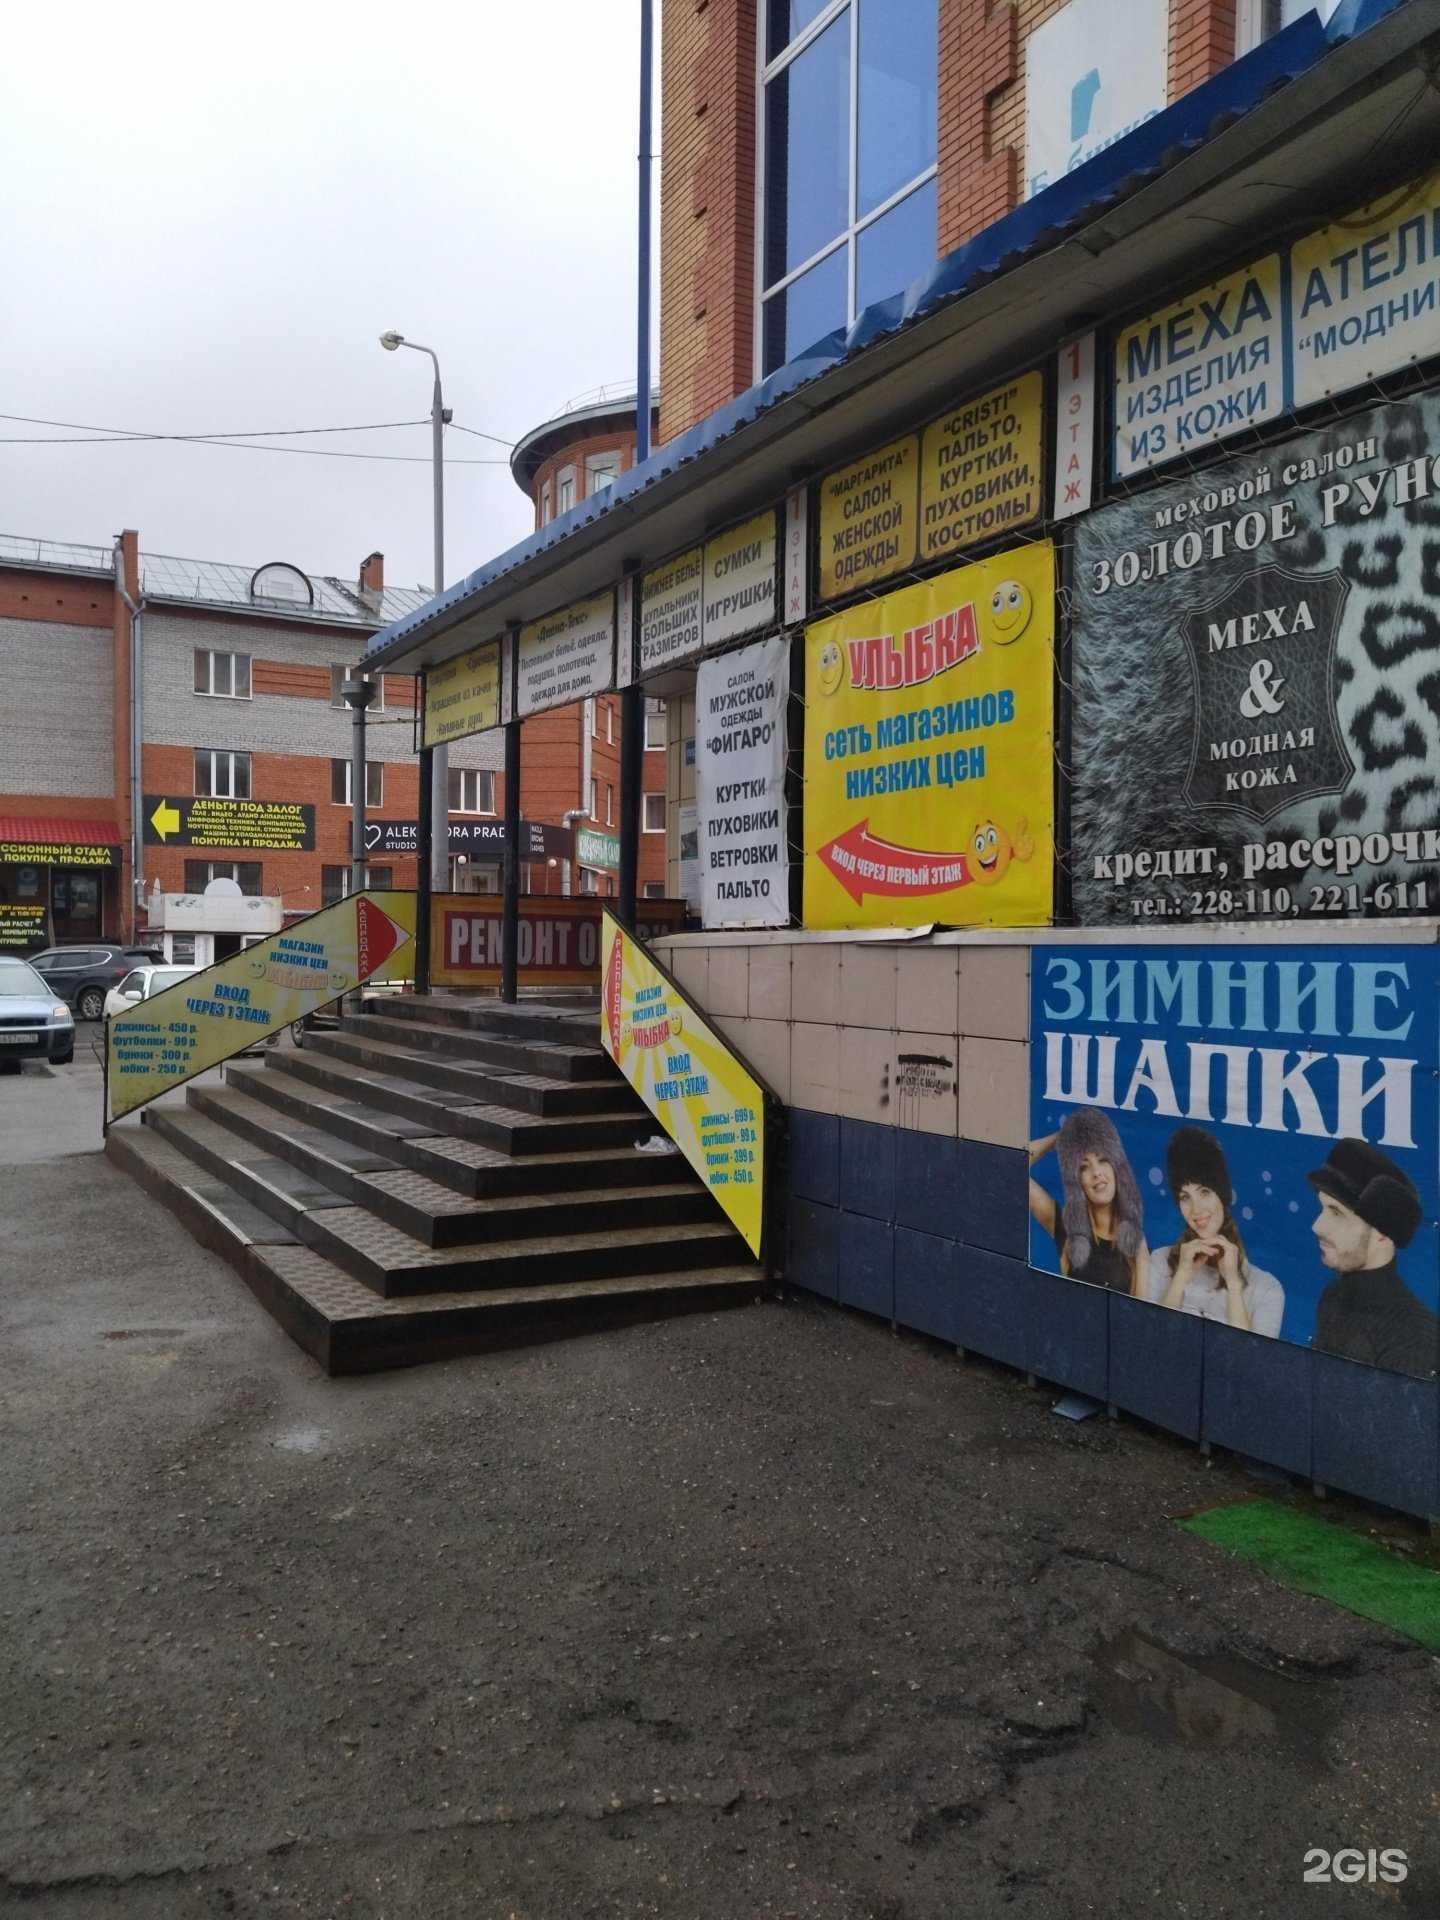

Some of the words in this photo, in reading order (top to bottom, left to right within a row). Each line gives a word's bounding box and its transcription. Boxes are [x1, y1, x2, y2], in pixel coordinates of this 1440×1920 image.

[1300, 206, 1440, 319] АТЕЛ
[1127, 277, 1272, 383] МЕХА
[1299, 280, 1440, 359] “МОДНИ
[1068, 342, 1080, 382] 1
[1127, 335, 1270, 424] ИЗДЕЛИЯ
[1130, 424, 1167, 462] ИЗ
[1177, 381, 1267, 445] КОЖИ
[938, 414, 1022, 467] ПАЛЬТО,
[1064, 394, 1082, 503] ЭТАЖ
[940, 442, 1019, 491] КУРТКИ,
[1154, 467, 1272, 530] меховой
[1282, 436, 1377, 488] салон
[844, 480, 892, 520] САЛОН
[925, 464, 1035, 525] ПУХОВИКИ,
[833, 503, 902, 554] ЖЕНСКОЙ
[928, 493, 1031, 550] КОСТЮМЫ
[1092, 499, 1297, 595] ЗОЛОТОЕ
[1322, 454, 1440, 528] РУН
[714, 541, 762, 579] СУМКИ
[790, 531, 801, 614] ЭТАЖ
[835, 535, 899, 581] ОДЕЖДЫ
[643, 588, 699, 624] КУПАЛЬНИКИ
[705, 578, 775, 624] ИГРУШКИ
[643, 605, 698, 642] БОЛЬШИХ
[1207, 600, 1316, 653] МЕХА
[642, 625, 699, 661] РАЗМЕРОВ
[848, 602, 981, 690] УЛЫБКА
[557, 681, 572, 696] для
[709, 679, 775, 714] МУЖСКОЙ
[727, 670, 755, 689] САЛОН
[1239, 658, 1286, 718] &
[720, 706, 763, 729] ОДЕЖДЫ
[824, 722, 872, 760] сеть
[876, 689, 1015, 751] магазинов
[1209, 727, 1316, 761] МОДНАЯ
[716, 777, 766, 804] КУРТКИ
[846, 752, 931, 800] низких
[936, 745, 985, 788] цен
[1226, 763, 1297, 791] КОЖА
[192, 800, 237, 810] ДЕНЬГИ
[240, 803, 264, 813] ПОД
[267, 805, 302, 814] ЗАЛОГ
[708, 809, 779, 837] ПУХОВИКИ
[59, 855, 112, 865] ПРОДАЖА
[75, 847, 111, 857] ОТДЕЛ
[191, 836, 240, 847] ПОКУПКА
[242, 839, 250, 847] И
[252, 840, 303, 849] ПРОДАЖА
[385, 842, 417, 850] STUDIO
[710, 843, 778, 869] ВЕТРОВКИ
[831, 844, 856, 872] ВХОД
[856, 858, 886, 882] ЧЕРЕЗ
[886, 863, 930, 886] ПЕРВЫЙ
[930, 863, 961, 886] ЭТАЖ
[1093, 846, 1228, 886] кредит,
[717, 878, 770, 900] ПАЛЬТО
[1191, 887, 1299, 917] 228-110,
[1310, 881, 1429, 912] 221-611
[279, 938, 324, 955] МАГАЗИН
[359, 902, 369, 972] РАСПРОДАЖА
[270, 952, 309, 968] НИЗКИХ
[309, 957, 329, 970] ЦЕН
[214, 984, 249, 1004] ВХОД
[614, 938, 622, 1047] РАСПРОДАЖА
[635, 985, 662, 1004] МАГАЗИН
[1043, 957, 1416, 1041] ЗИМНИЕ
[114, 1023, 160, 1033] джинсы
[168, 1022, 188, 1033] 450
[186, 998, 225, 1017] ЧЕРЕЗ
[228, 1006, 234, 1017] 1
[235, 1007, 271, 1024] ЭТАЖ
[632, 1008, 655, 1023] НИЗКИХ
[655, 1002, 667, 1018] ЦЕН
[112, 1035, 166, 1047] футболки
[632, 1020, 670, 1048] УЛЫБКА
[118, 1049, 153, 1062] брюки
[161, 1050, 180, 1061] 300
[120, 1063, 150, 1074] юбки
[157, 1063, 177, 1074] 250
[667, 1053, 690, 1074] ВХОД
[653, 1081, 679, 1101] ЧЕРЕЗ
[684, 1075, 709, 1096] ЭТАЖ
[1042, 1031, 1419, 1149] ШАПКИ
